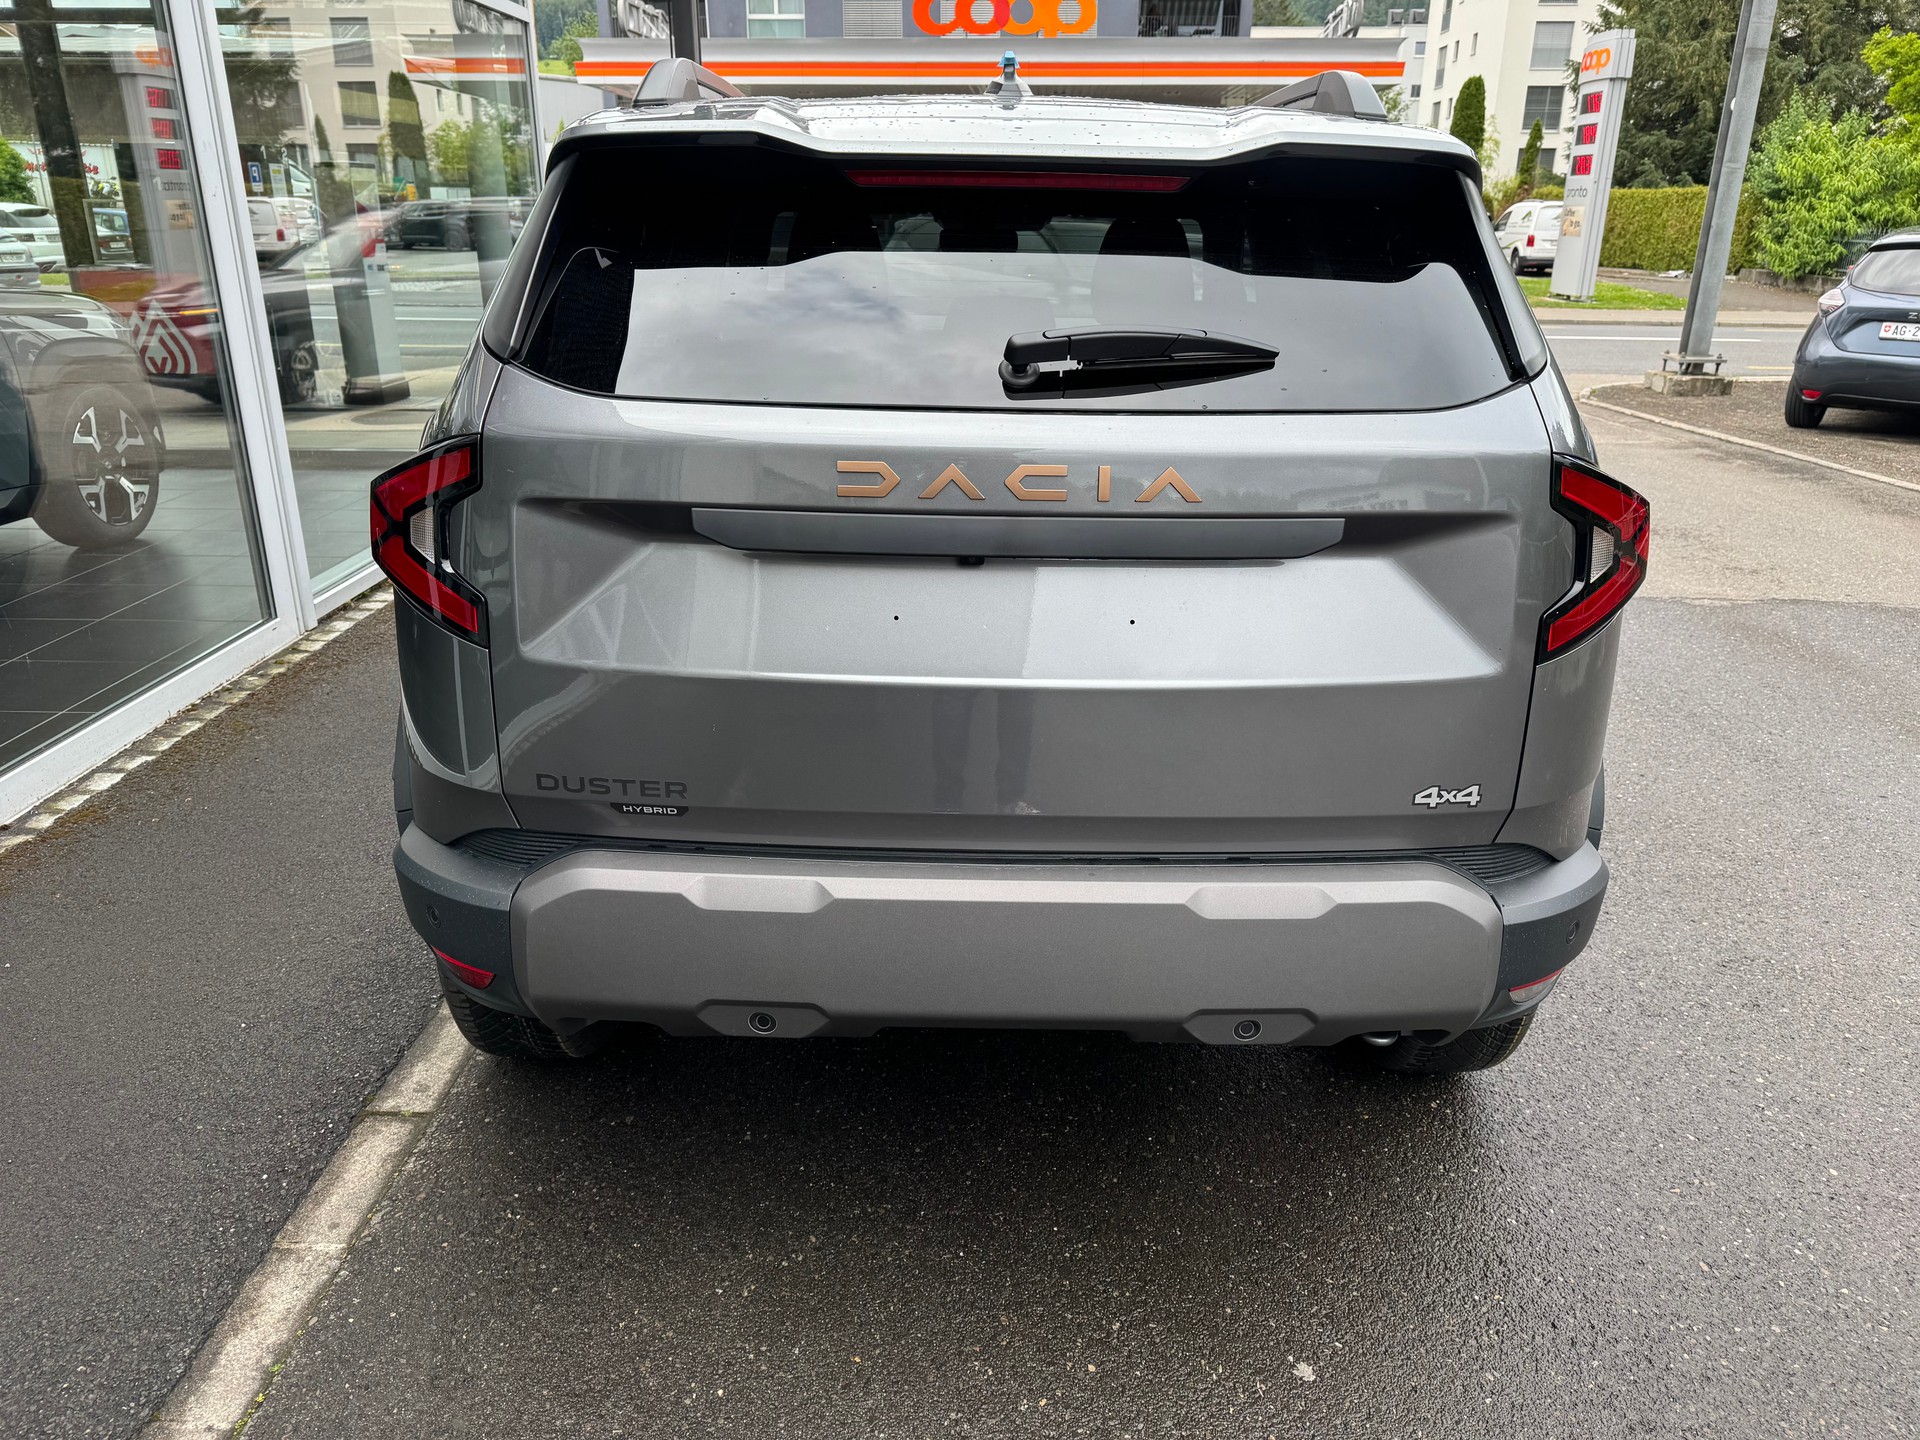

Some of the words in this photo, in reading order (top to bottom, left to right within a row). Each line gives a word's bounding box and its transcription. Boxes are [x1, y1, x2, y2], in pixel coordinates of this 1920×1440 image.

[837, 460, 1202, 502] DACIA
[536, 773, 688, 799] DUSTER
[1413, 784, 1482, 808] 4x4
[623, 805, 678, 815] HYBRID
